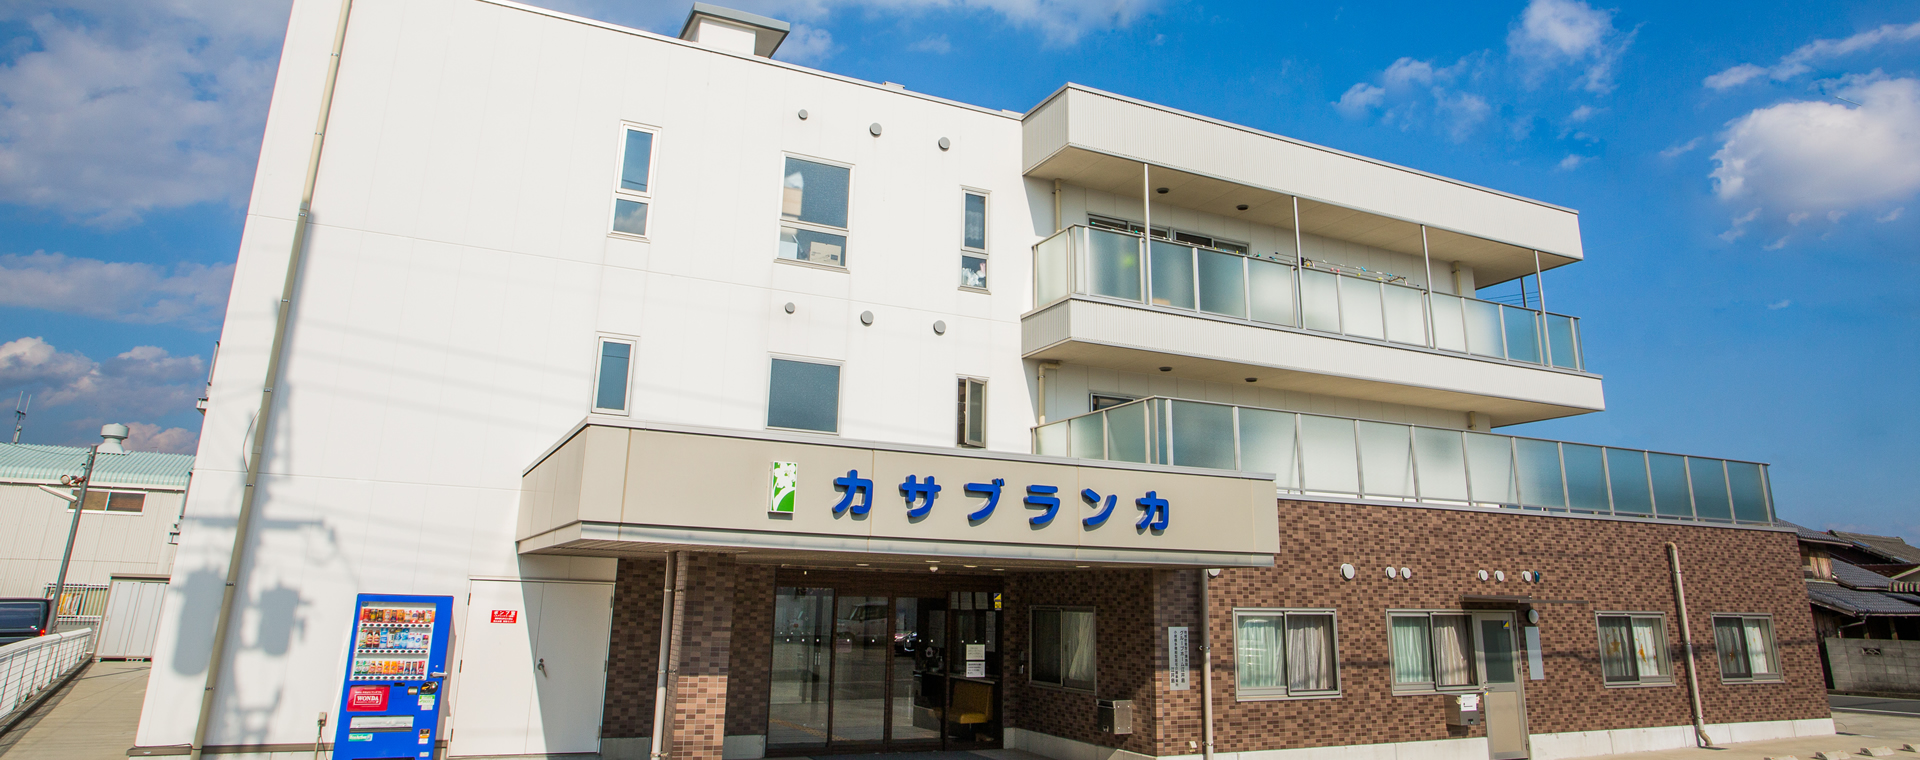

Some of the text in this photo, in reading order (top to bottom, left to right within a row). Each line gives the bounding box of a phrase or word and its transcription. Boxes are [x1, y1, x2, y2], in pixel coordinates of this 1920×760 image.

[832, 469, 1170, 530] カサブランカ
